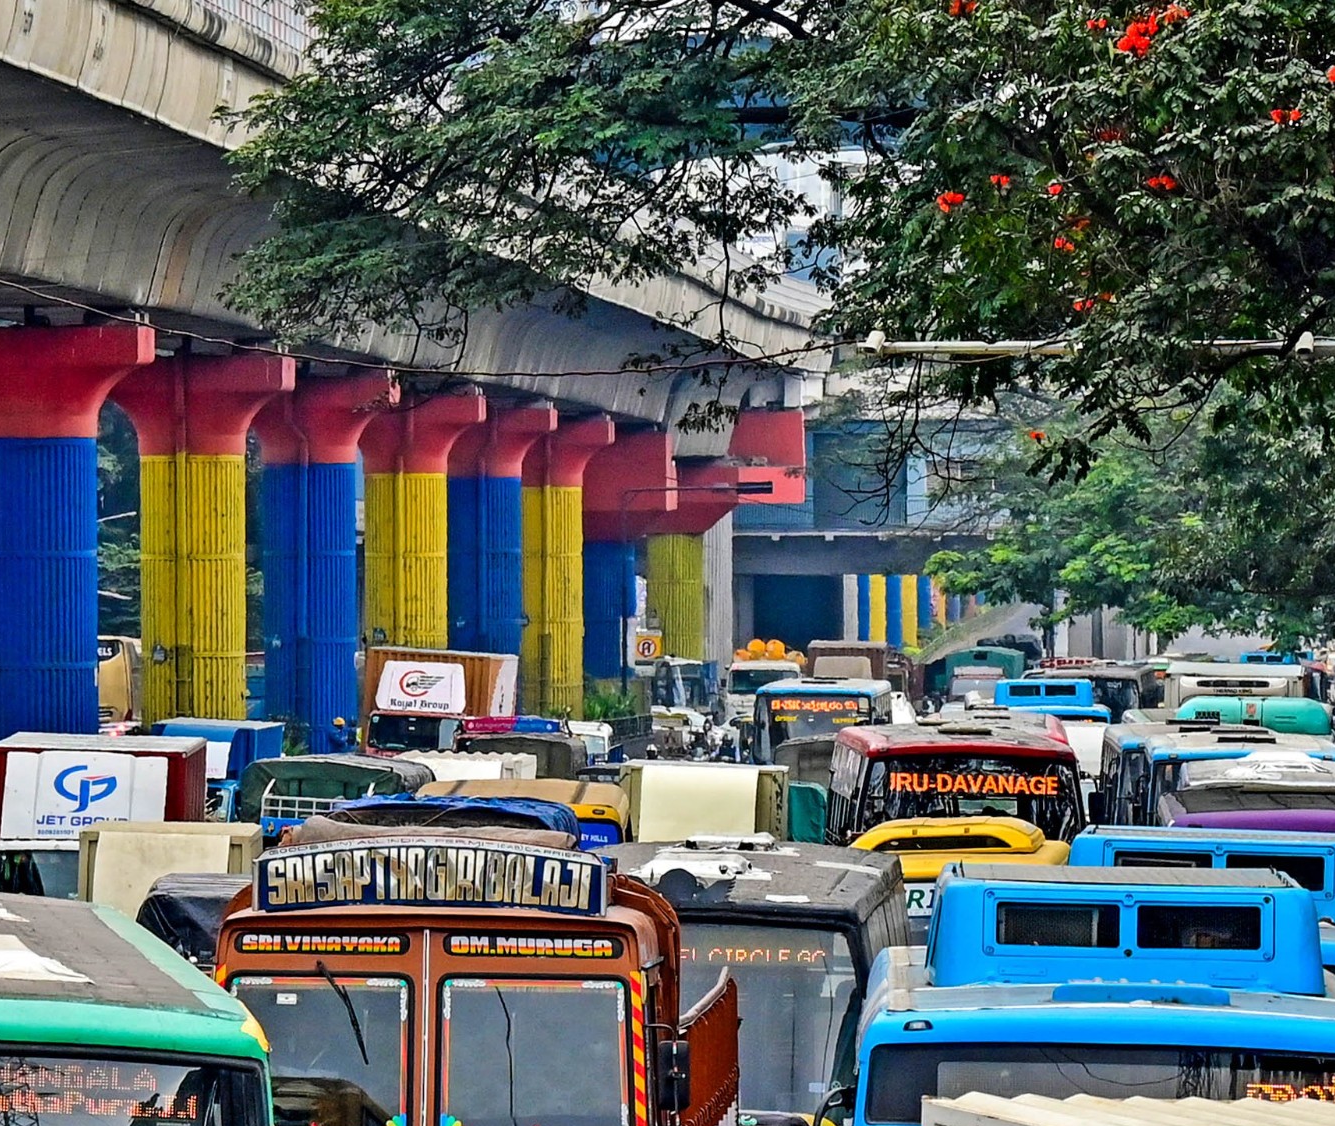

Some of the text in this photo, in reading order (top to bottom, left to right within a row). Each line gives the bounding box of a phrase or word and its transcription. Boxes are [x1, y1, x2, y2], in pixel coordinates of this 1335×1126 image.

[390, 699, 449, 711] Royal Group
[36, 815, 66, 826] JET
